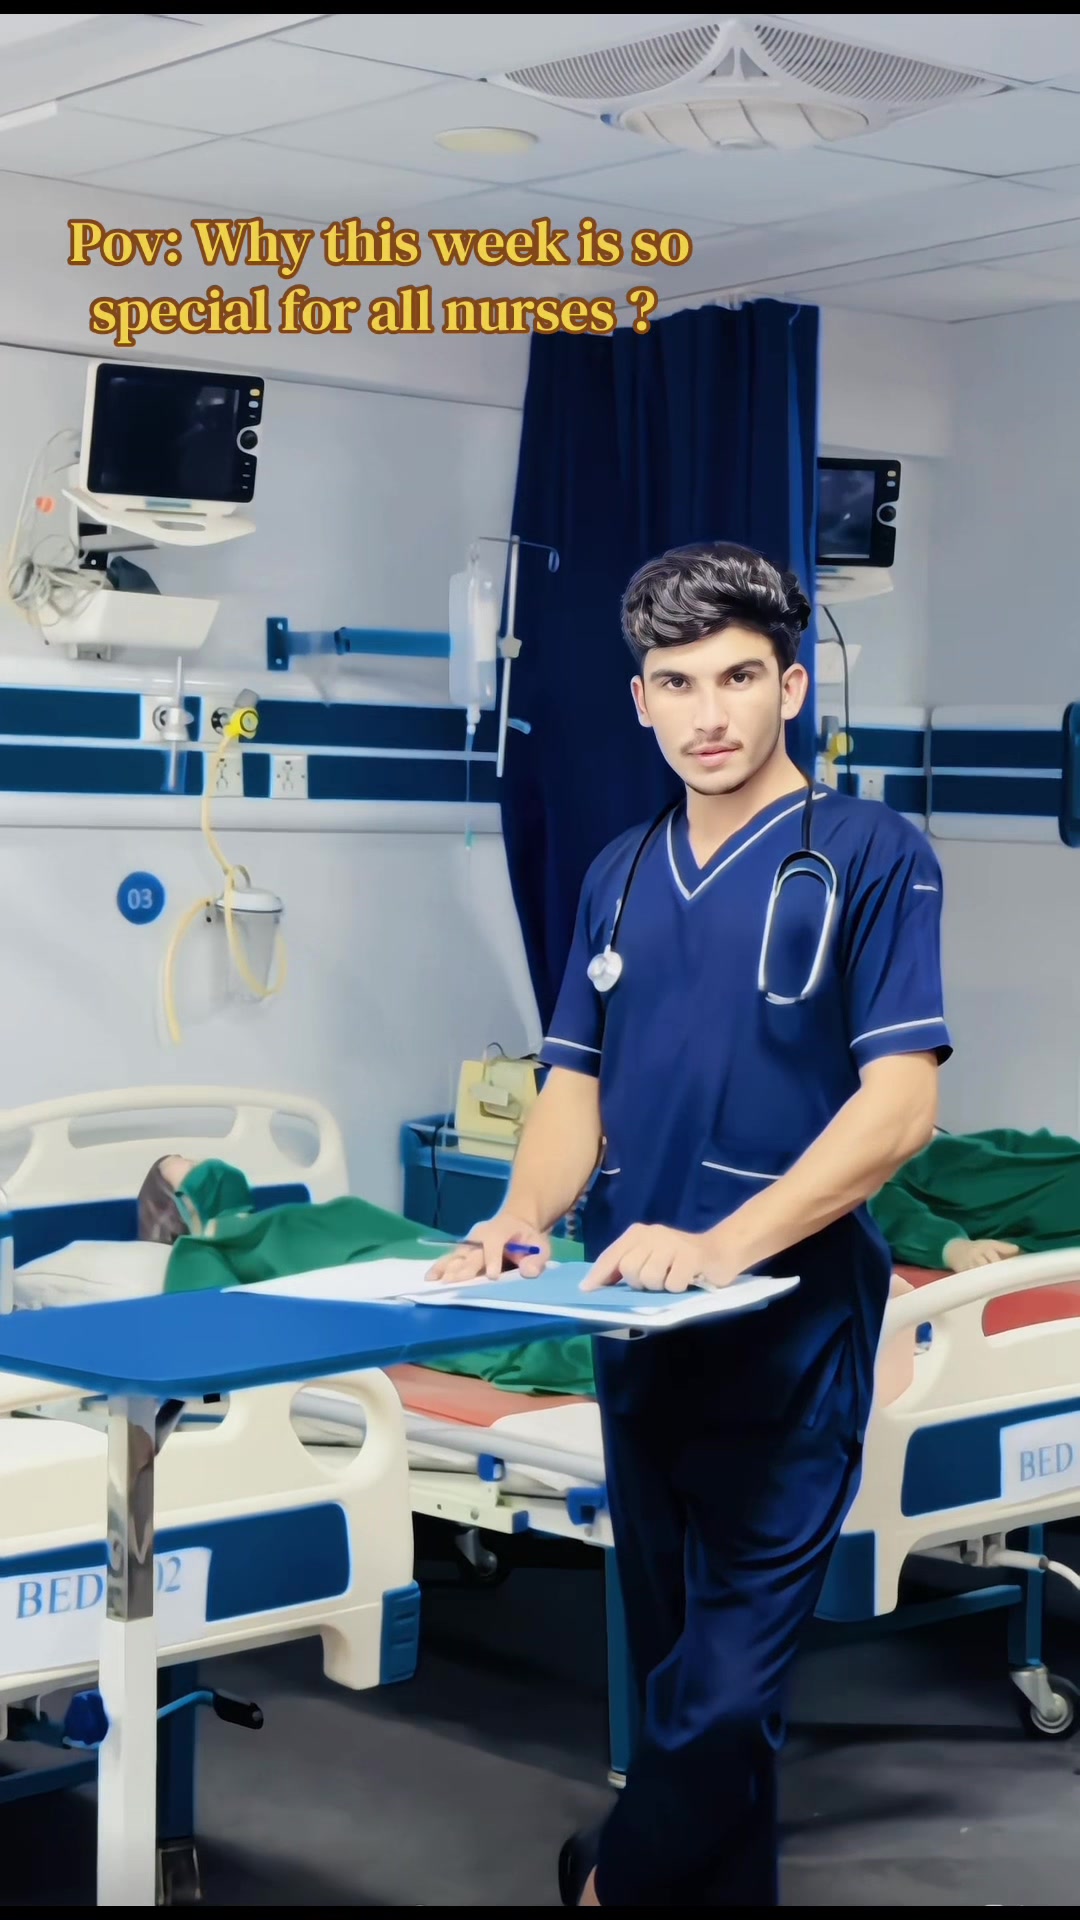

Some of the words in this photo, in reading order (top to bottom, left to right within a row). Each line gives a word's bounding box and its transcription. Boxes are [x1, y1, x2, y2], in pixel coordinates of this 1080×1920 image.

[127, 887, 153, 910] 03
[1019, 1442, 1073, 1482] BED
[16, 1573, 104, 1619] BED
[154, 1555, 182, 1593] 2
